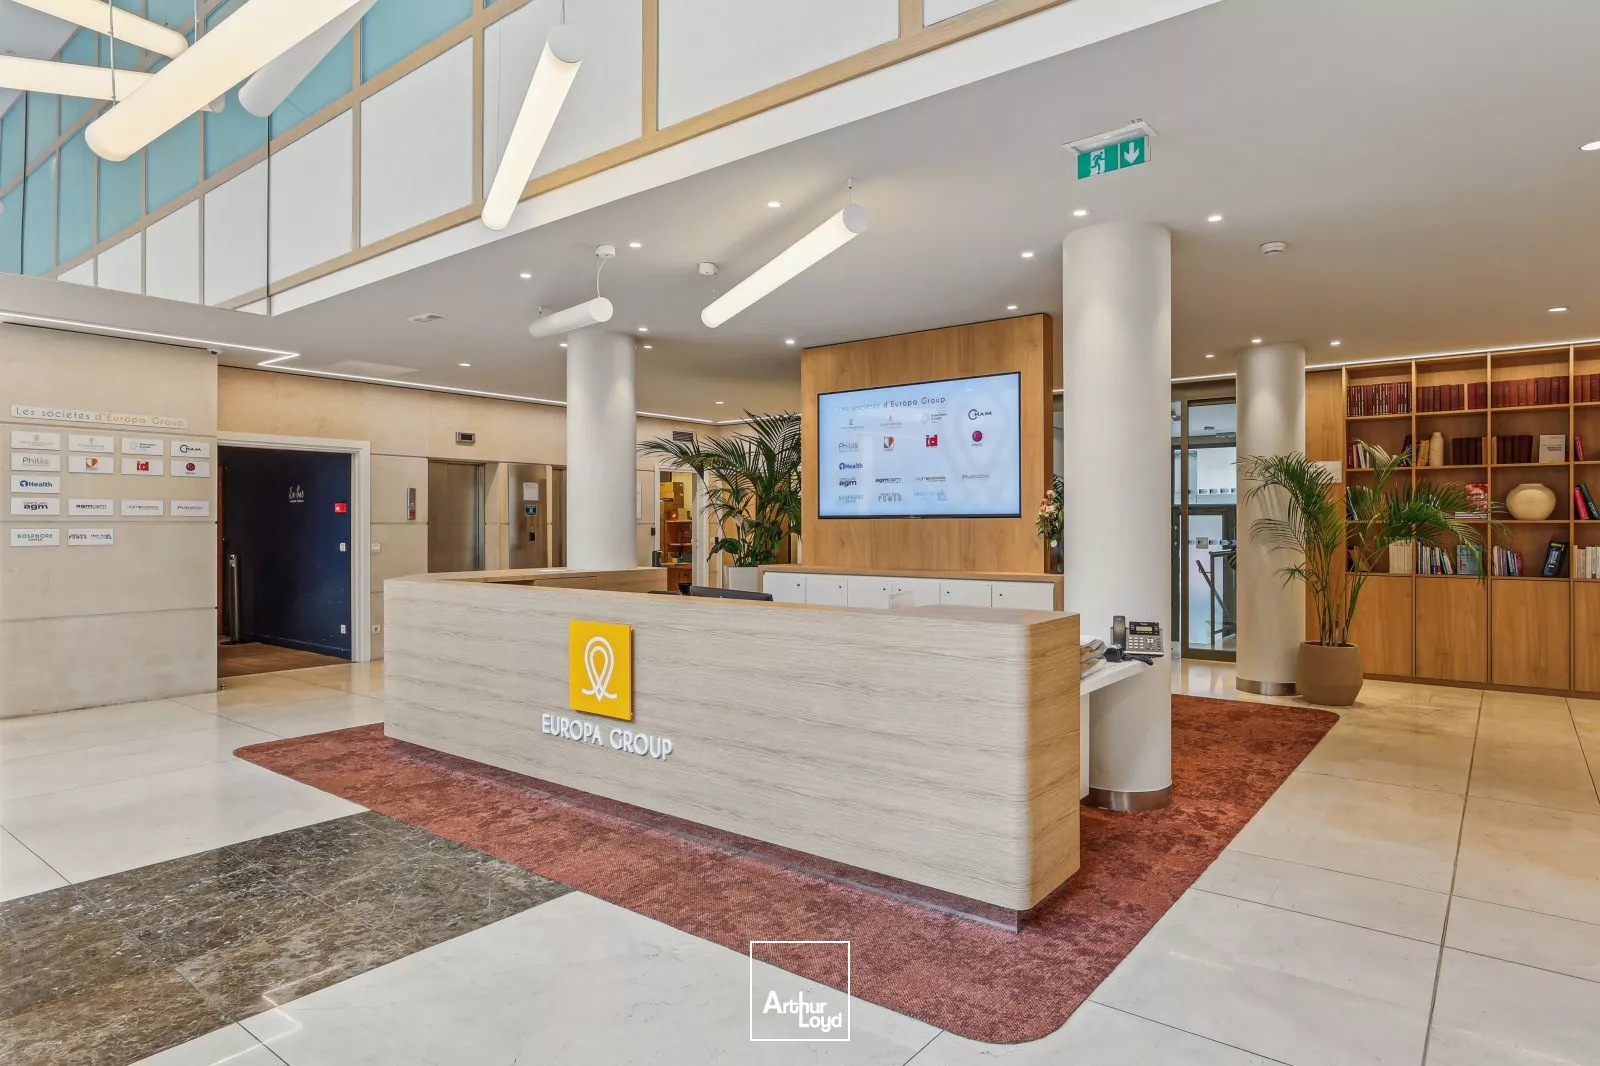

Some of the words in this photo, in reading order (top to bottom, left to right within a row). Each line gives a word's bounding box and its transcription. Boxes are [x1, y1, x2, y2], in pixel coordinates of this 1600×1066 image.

[883, 400, 918, 409] d'Europa
[921, 397, 946, 405] Group
[16, 406, 36, 416] Les
[95, 412, 146, 424] d'Europa
[151, 417, 184, 428] Group
[967, 408, 993, 421] CHAM
[179, 444, 202, 453] CHAM
[23, 503, 49, 511] agm
[541, 713, 603, 746] EUROPA
[609, 728, 673, 761] GROUP
